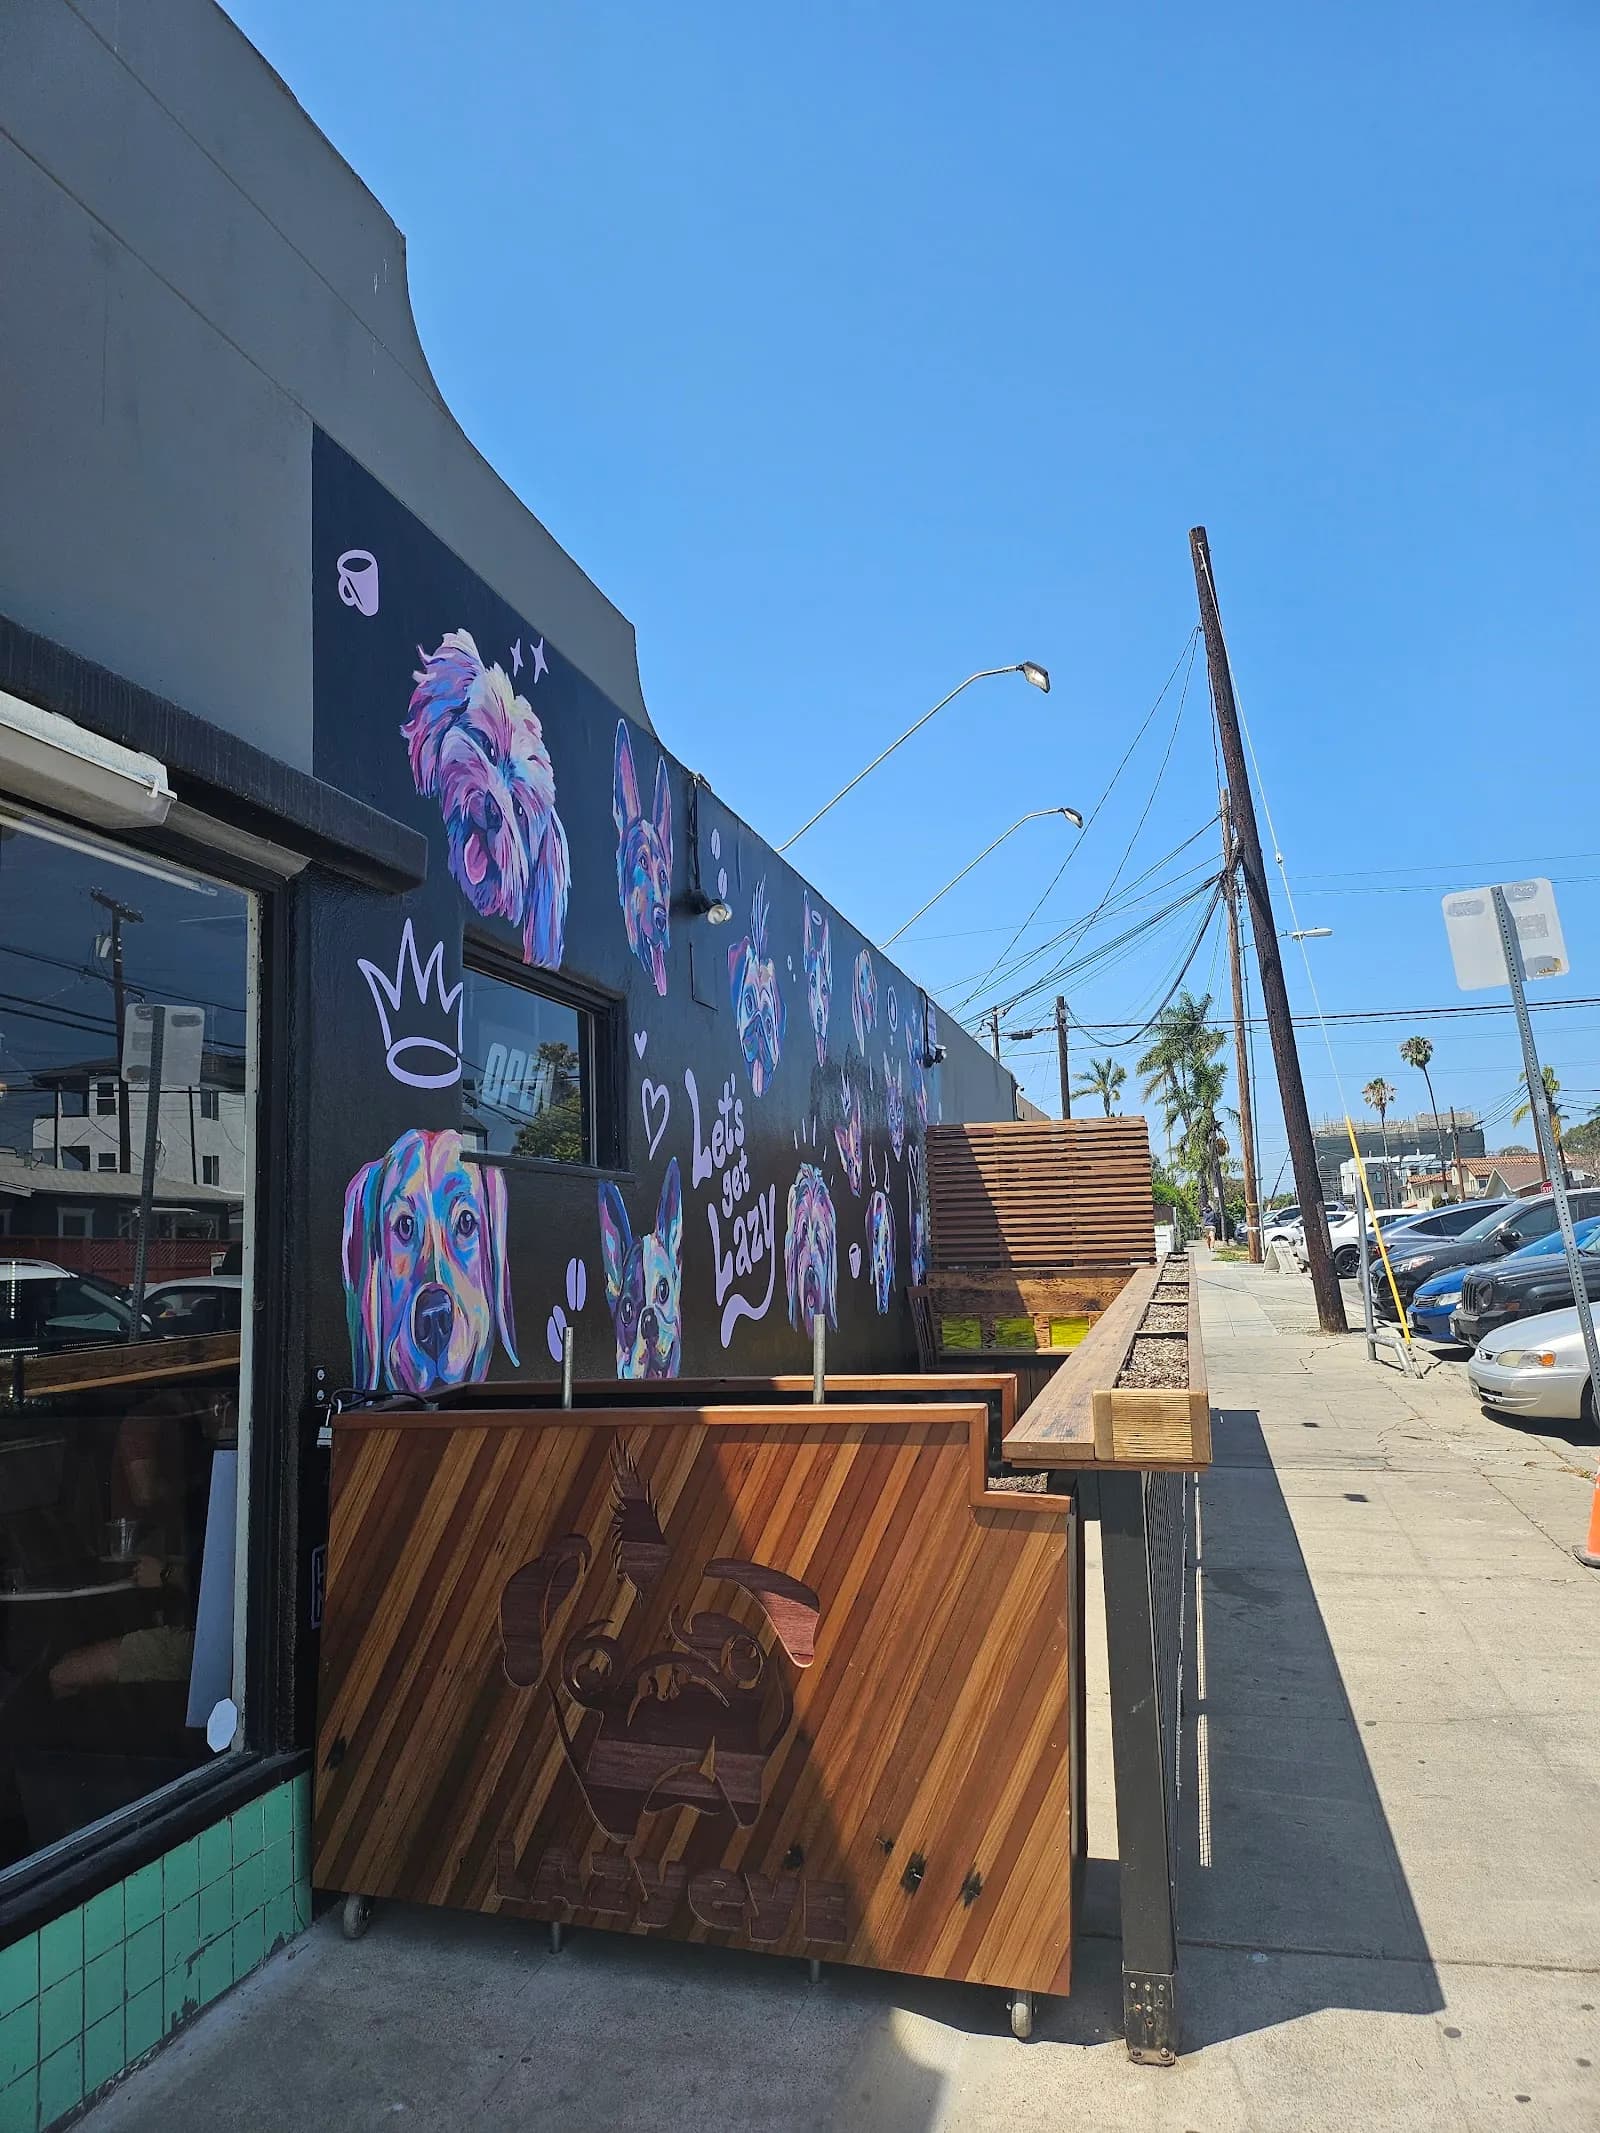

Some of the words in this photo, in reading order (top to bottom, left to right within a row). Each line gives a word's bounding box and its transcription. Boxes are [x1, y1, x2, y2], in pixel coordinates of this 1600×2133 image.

[685, 1068, 745, 1189] Let's
[722, 1148, 750, 1219] get
[708, 1184, 775, 1348] Lazy
